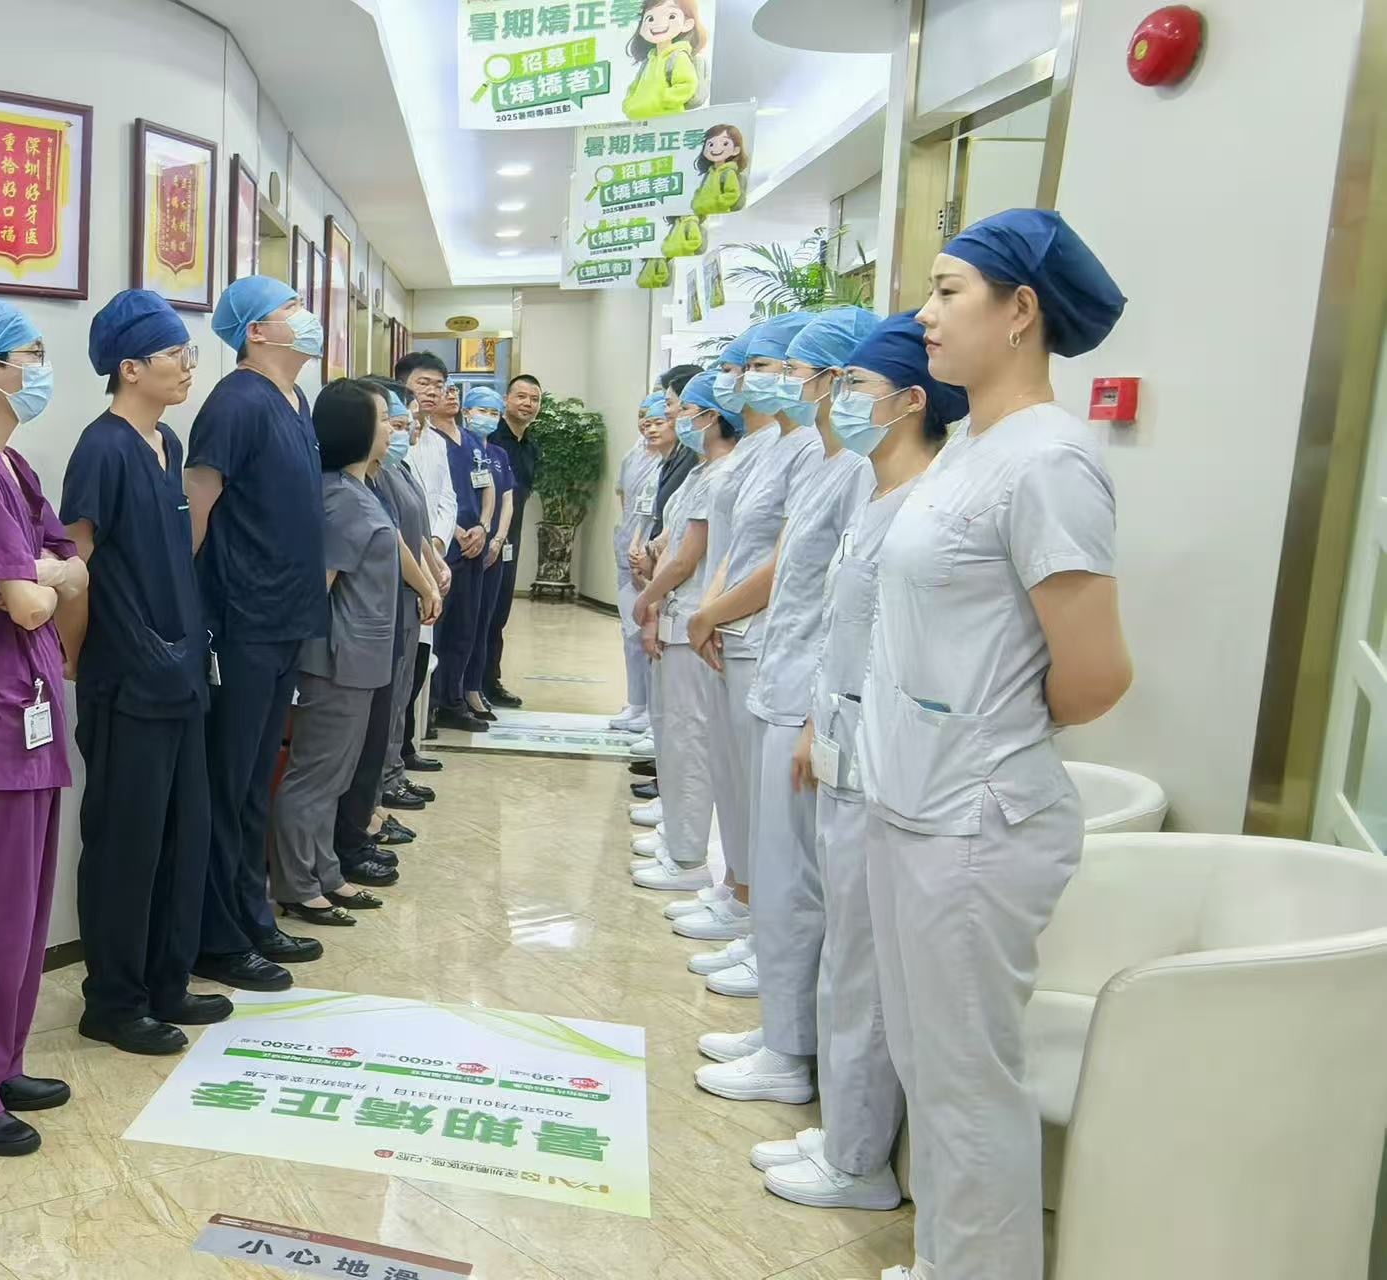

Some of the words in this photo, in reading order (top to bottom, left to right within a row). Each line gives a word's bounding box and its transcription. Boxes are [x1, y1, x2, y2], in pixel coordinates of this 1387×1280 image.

[0, 132, 19, 243] 重拾好口福
